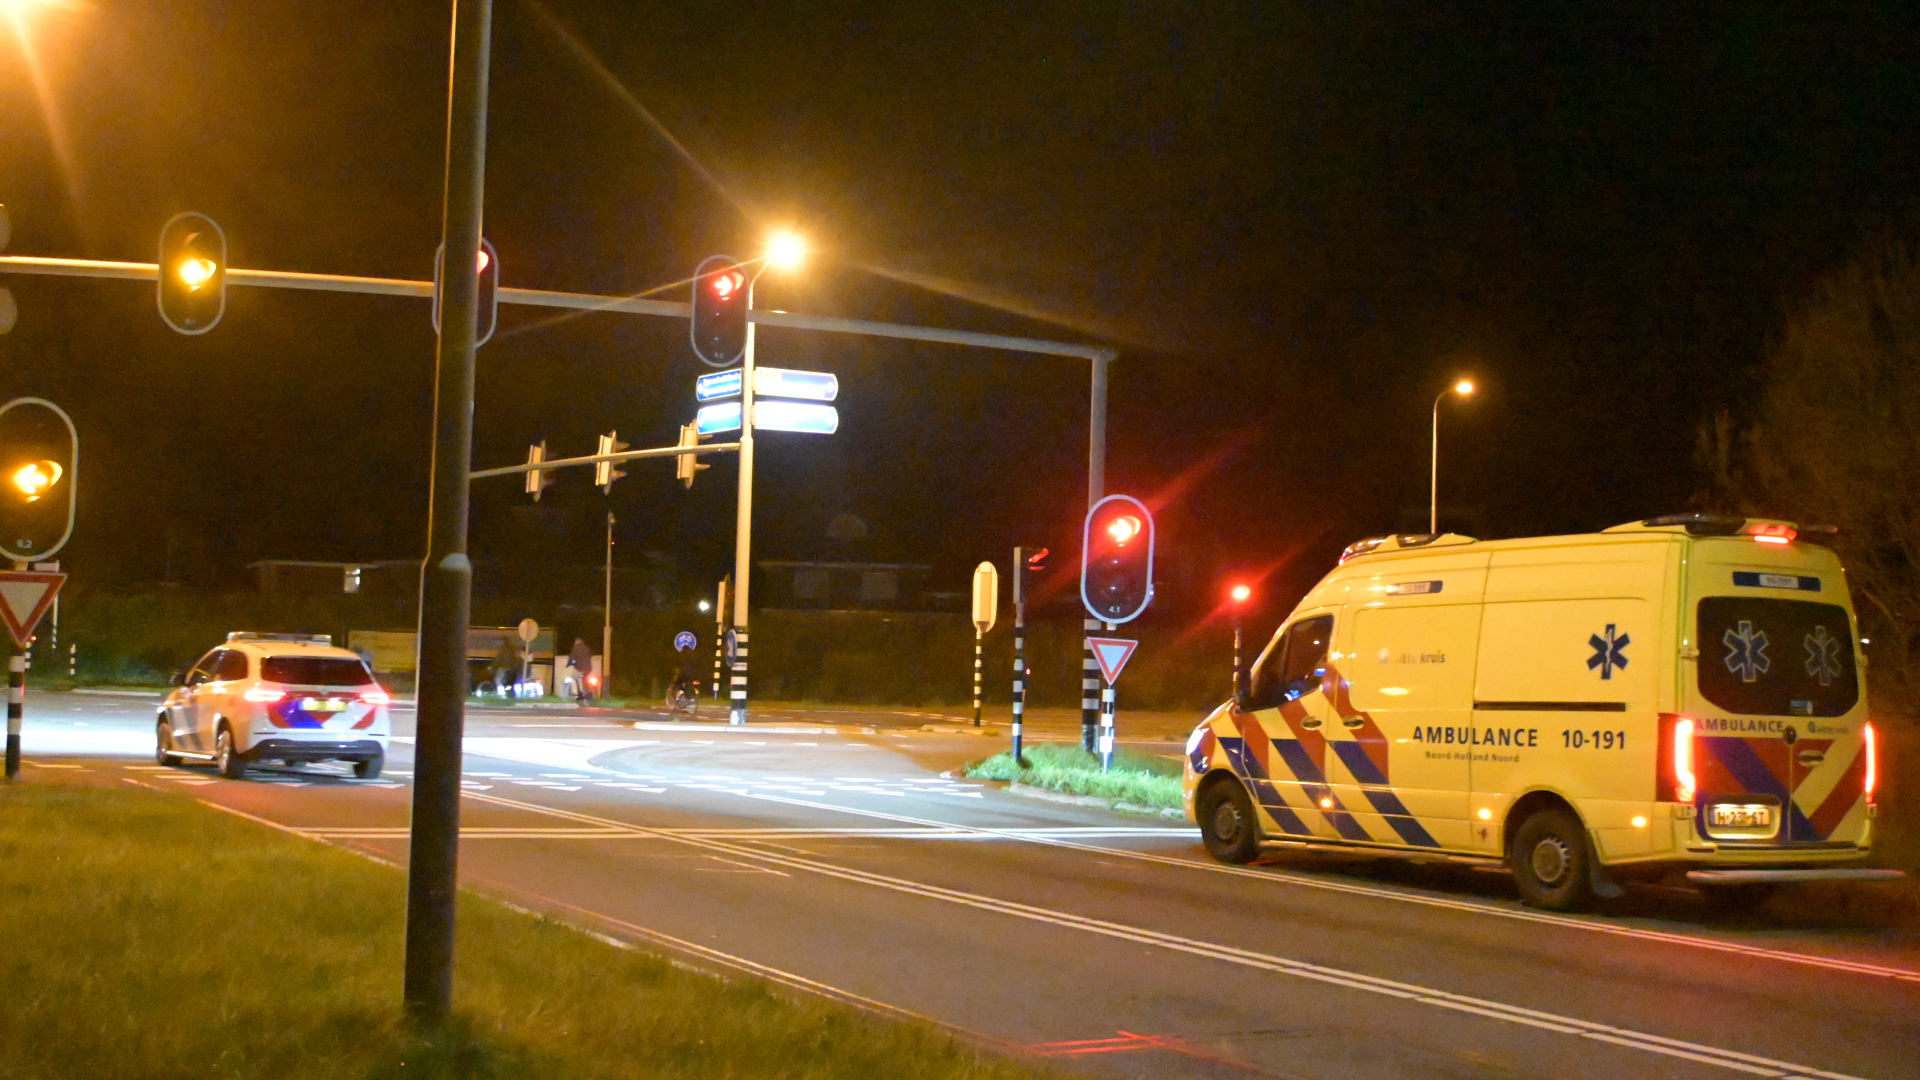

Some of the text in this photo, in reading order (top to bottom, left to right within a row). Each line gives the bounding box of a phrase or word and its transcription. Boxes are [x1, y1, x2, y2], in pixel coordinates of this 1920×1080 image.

[1420, 650, 1446, 663] kruis
[1694, 717, 1786, 734] AMBULANCE
[1412, 726, 1625, 750] AMBULANCE 10-191
